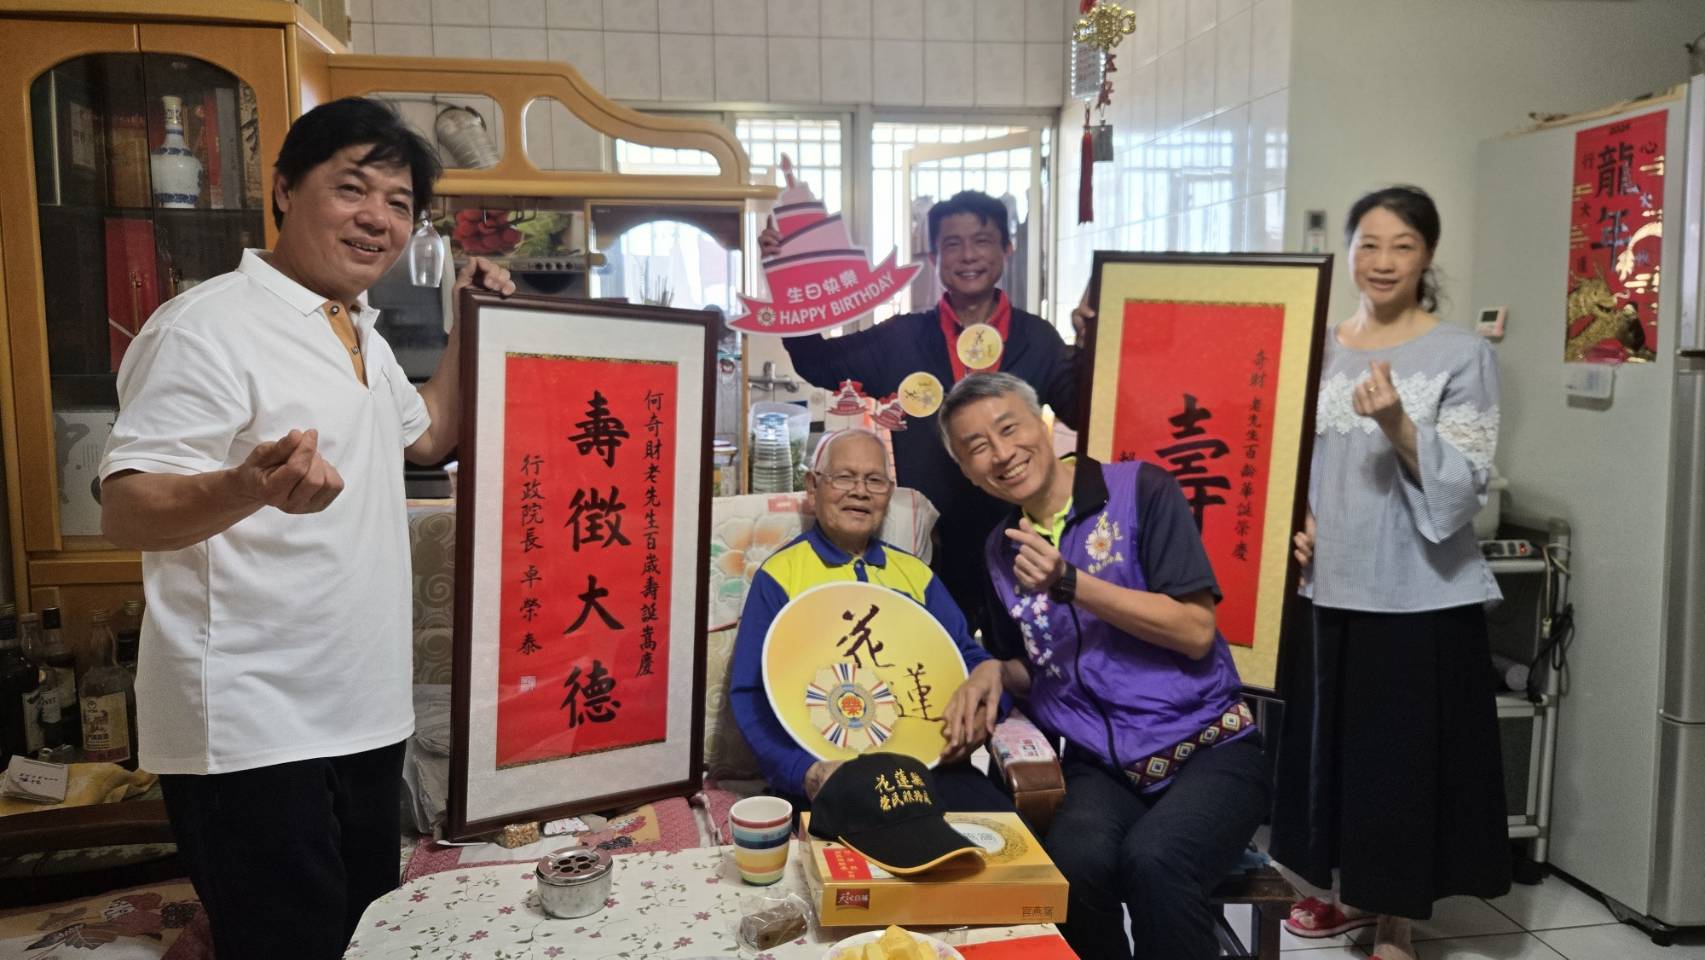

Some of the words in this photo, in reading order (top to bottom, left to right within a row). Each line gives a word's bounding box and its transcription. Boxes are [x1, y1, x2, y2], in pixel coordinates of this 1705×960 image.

[1591, 141, 1640, 273] 龍年
[780, 304, 827, 325] HAPPY
[830, 271, 895, 316] BIRTHDAY
[787, 269, 858, 304] 生日快樂
[519, 454, 545, 655] 行政院長卓榮泰
